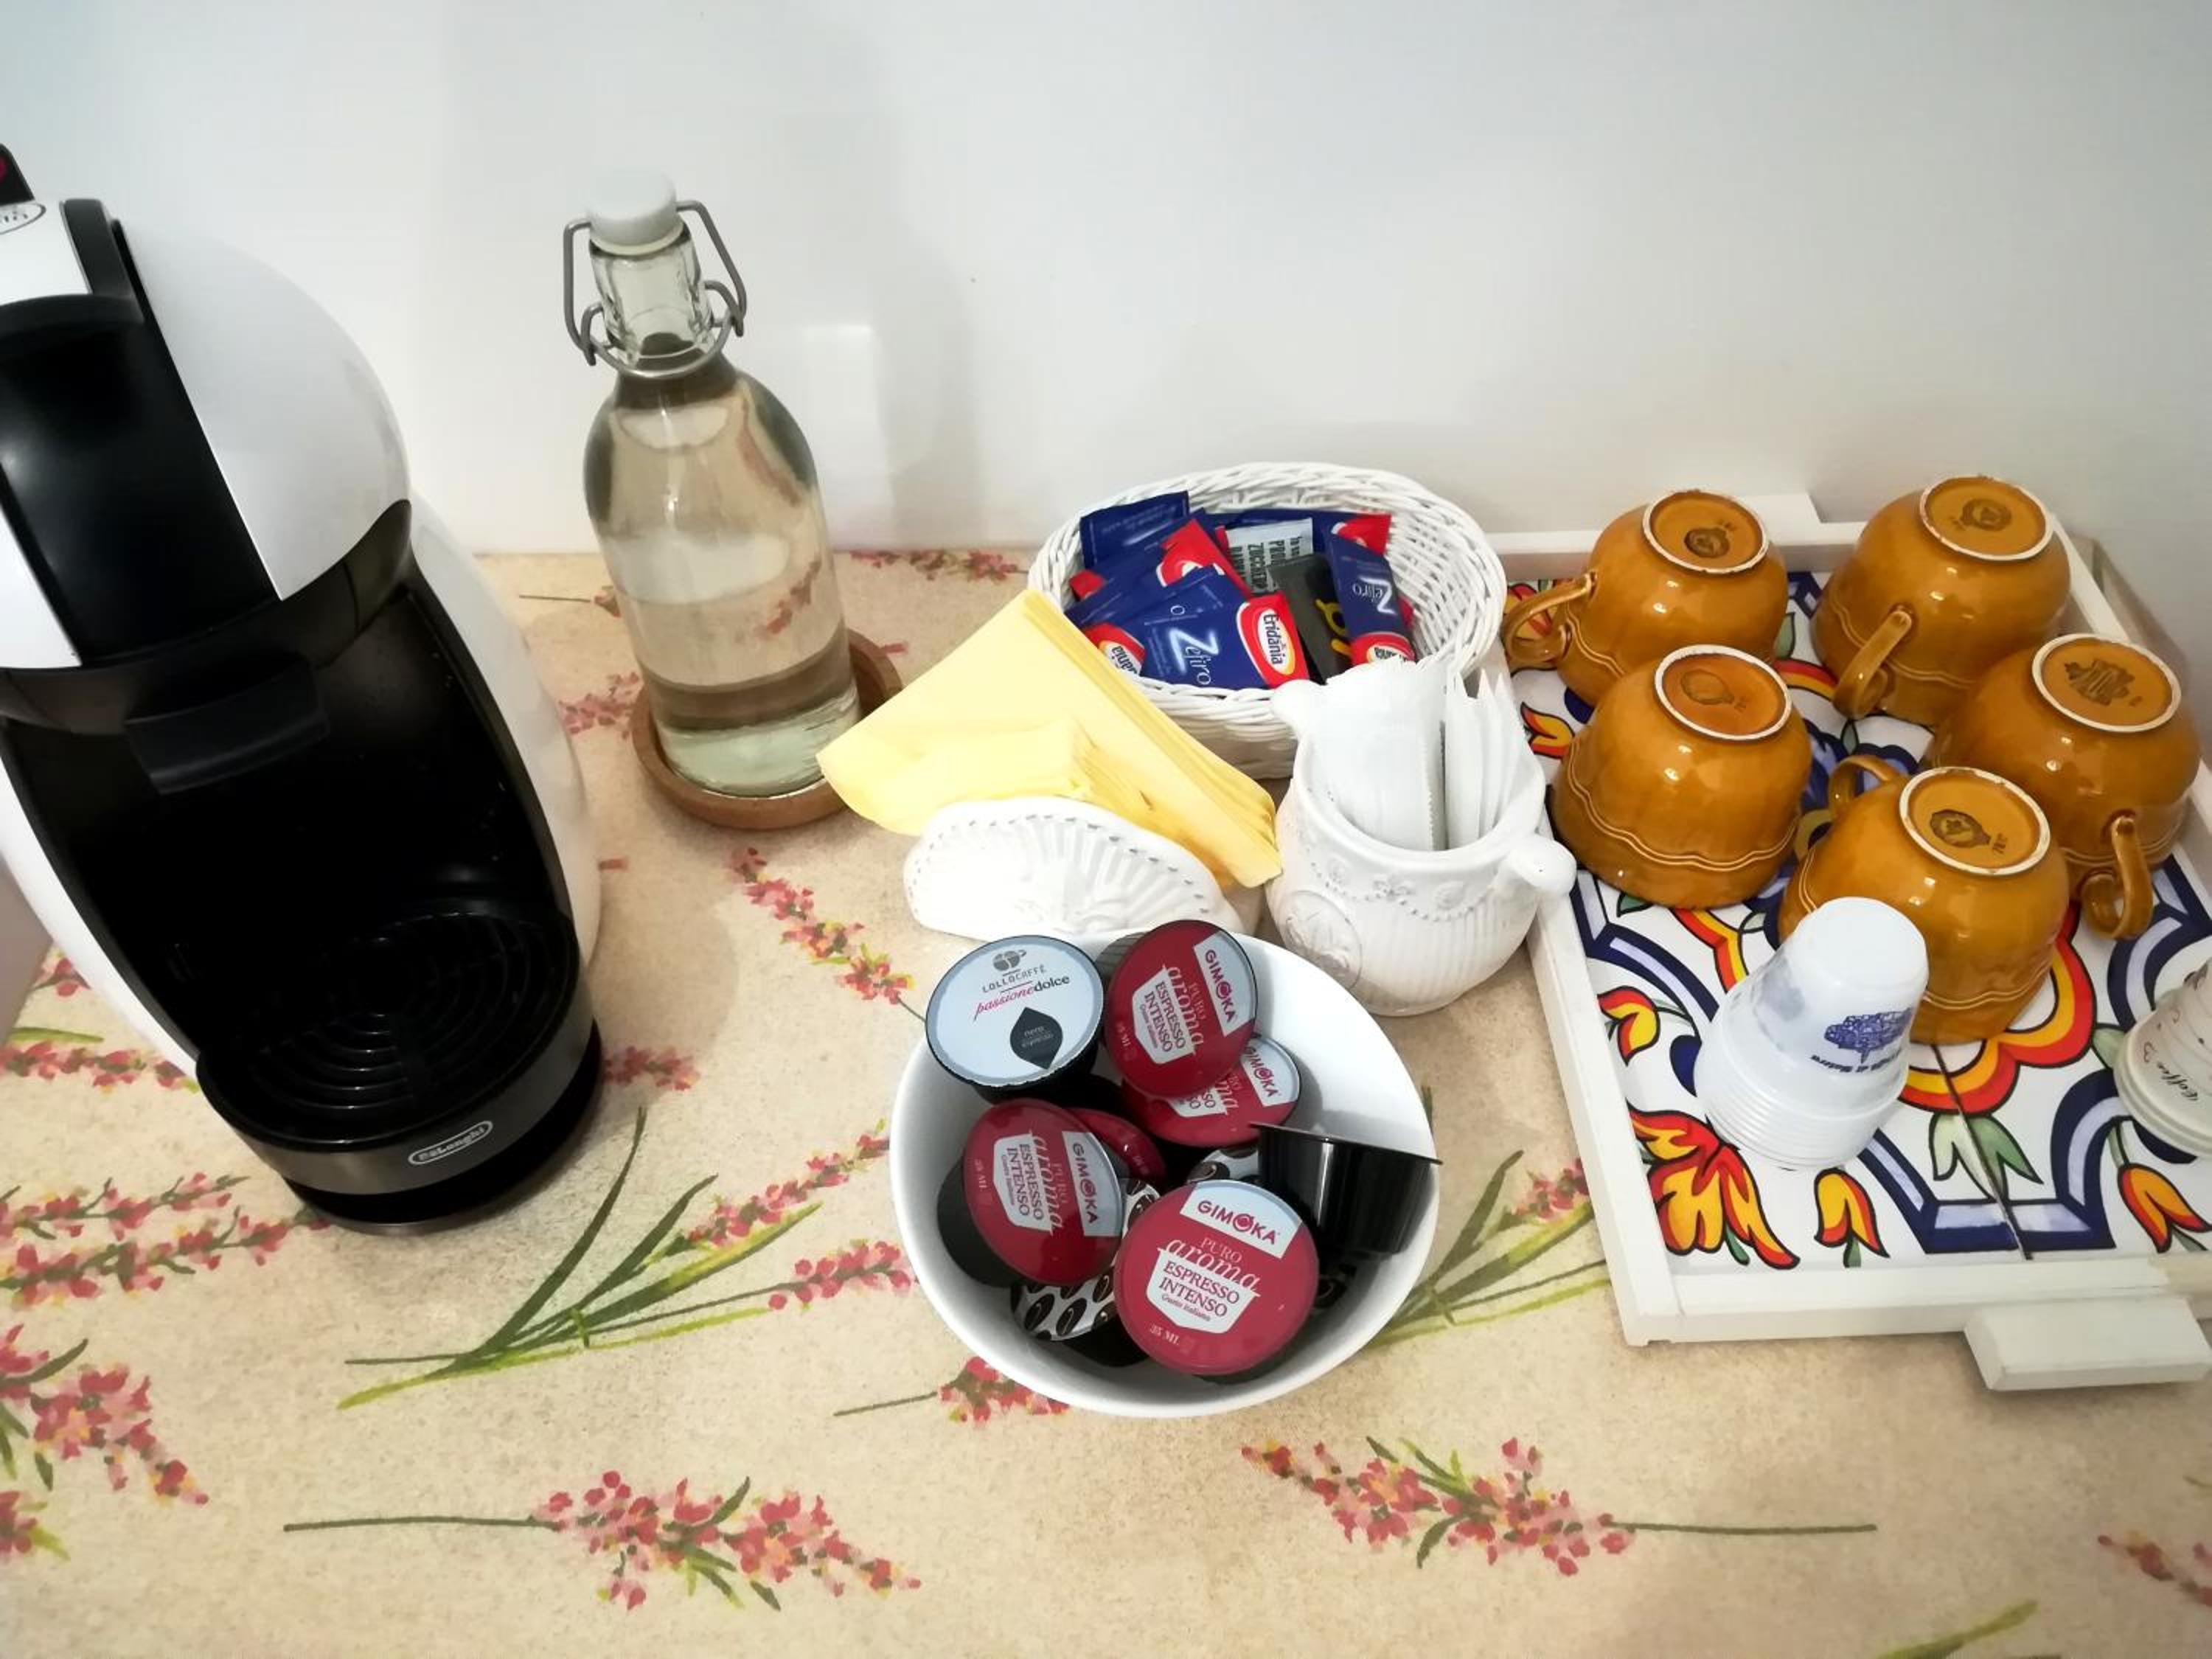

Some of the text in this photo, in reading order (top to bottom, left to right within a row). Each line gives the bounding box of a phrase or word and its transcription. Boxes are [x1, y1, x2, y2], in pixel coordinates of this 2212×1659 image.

[1352, 575, 1397, 615] Zefiro
[1169, 627, 1219, 686] Zefiro
[1263, 613, 1286, 664] Eridania
[1155, 981, 1187, 1049] ESPRESSO
[1167, 966, 1204, 1046] aroma
[1204, 948, 1237, 1023] GIMOKA
[1144, 990, 1174, 1052] INTENSO
[1007, 1147, 1030, 1217] INTENSO
[1020, 1144, 1044, 1221] ESPRESSO
[1033, 1135, 1064, 1228] aroma
[1073, 1143, 1099, 1225] GIMOKA
[1197, 1200, 1276, 1245] GIMOKA
[1200, 1237, 1242, 1264] PURO
[1162, 1260, 1240, 1304] ESPRESSO
[1164, 1238, 1261, 1292] aroma
[1158, 1276, 1228, 1318] INTENSO
